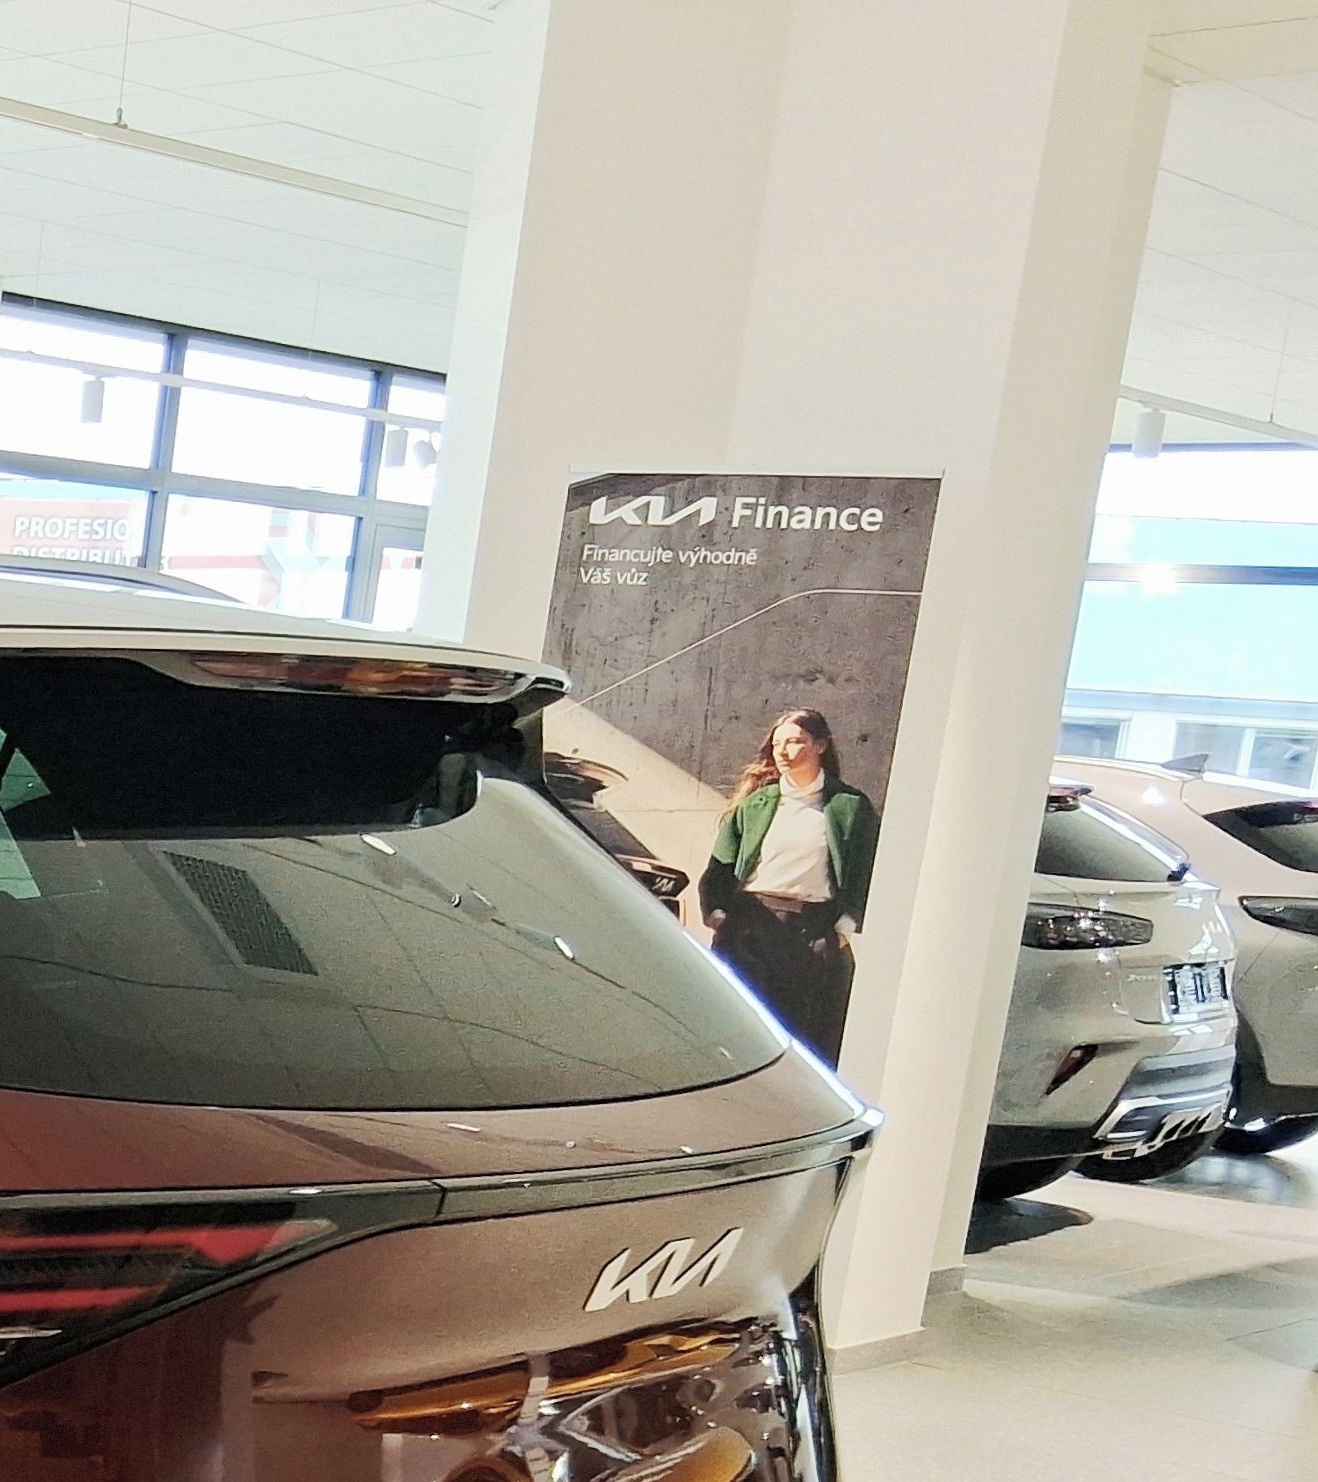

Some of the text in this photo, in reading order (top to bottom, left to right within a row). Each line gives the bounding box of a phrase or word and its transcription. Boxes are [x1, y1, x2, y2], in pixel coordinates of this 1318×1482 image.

[589, 495, 884, 531] KIA Finance
[15, 517, 131, 540] PROFESIO
[582, 544, 758, 567] Financujte výhodně
[579, 565, 649, 586] Váš vůz
[584, 1226, 744, 1313] KIA
